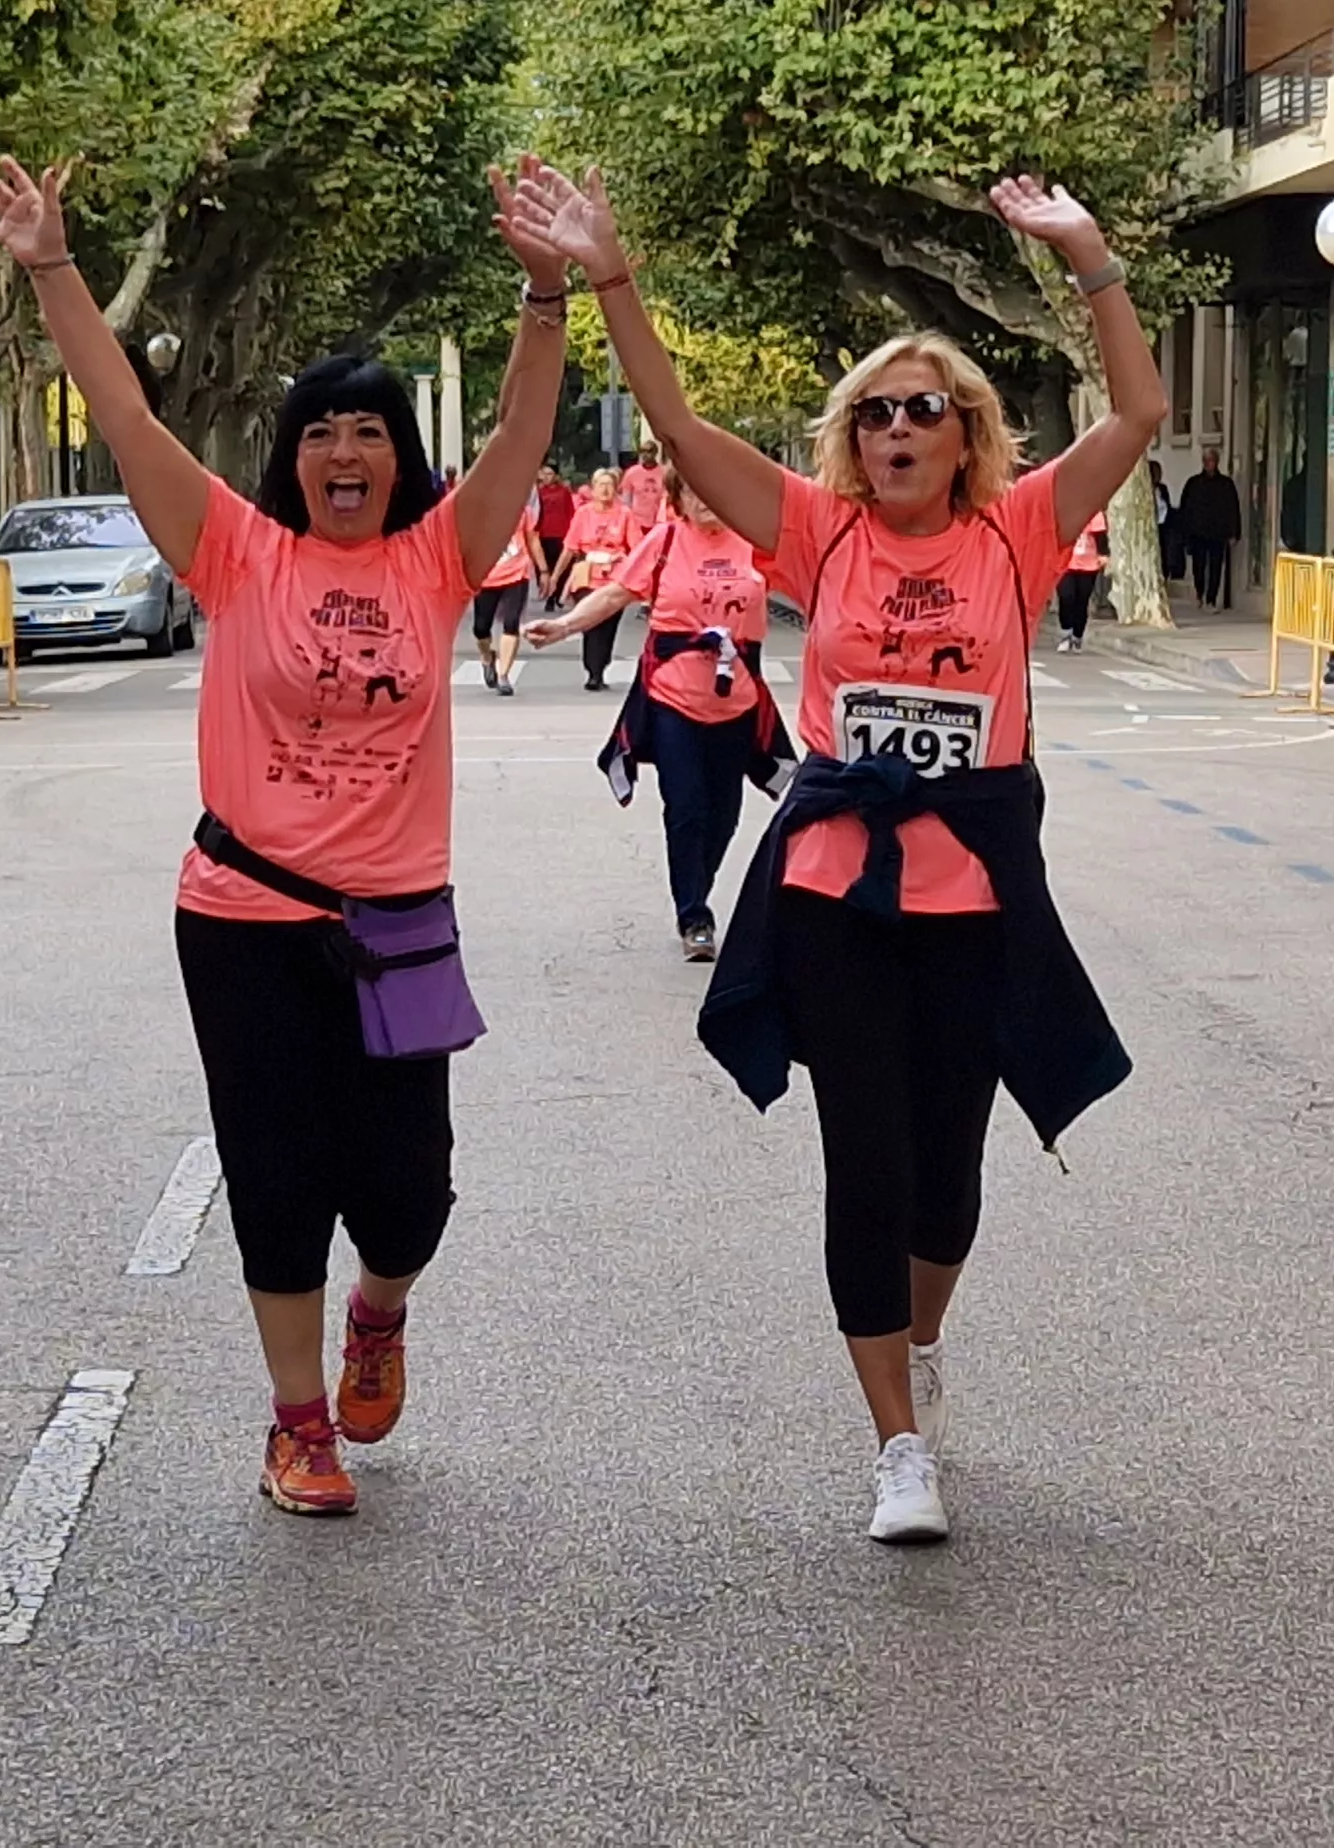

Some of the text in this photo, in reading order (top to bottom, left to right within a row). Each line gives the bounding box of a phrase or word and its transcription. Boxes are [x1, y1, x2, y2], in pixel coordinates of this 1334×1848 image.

[852, 704, 903, 719] CONTRA
[908, 708, 920, 721] EL
[852, 724, 972, 772] 1493
